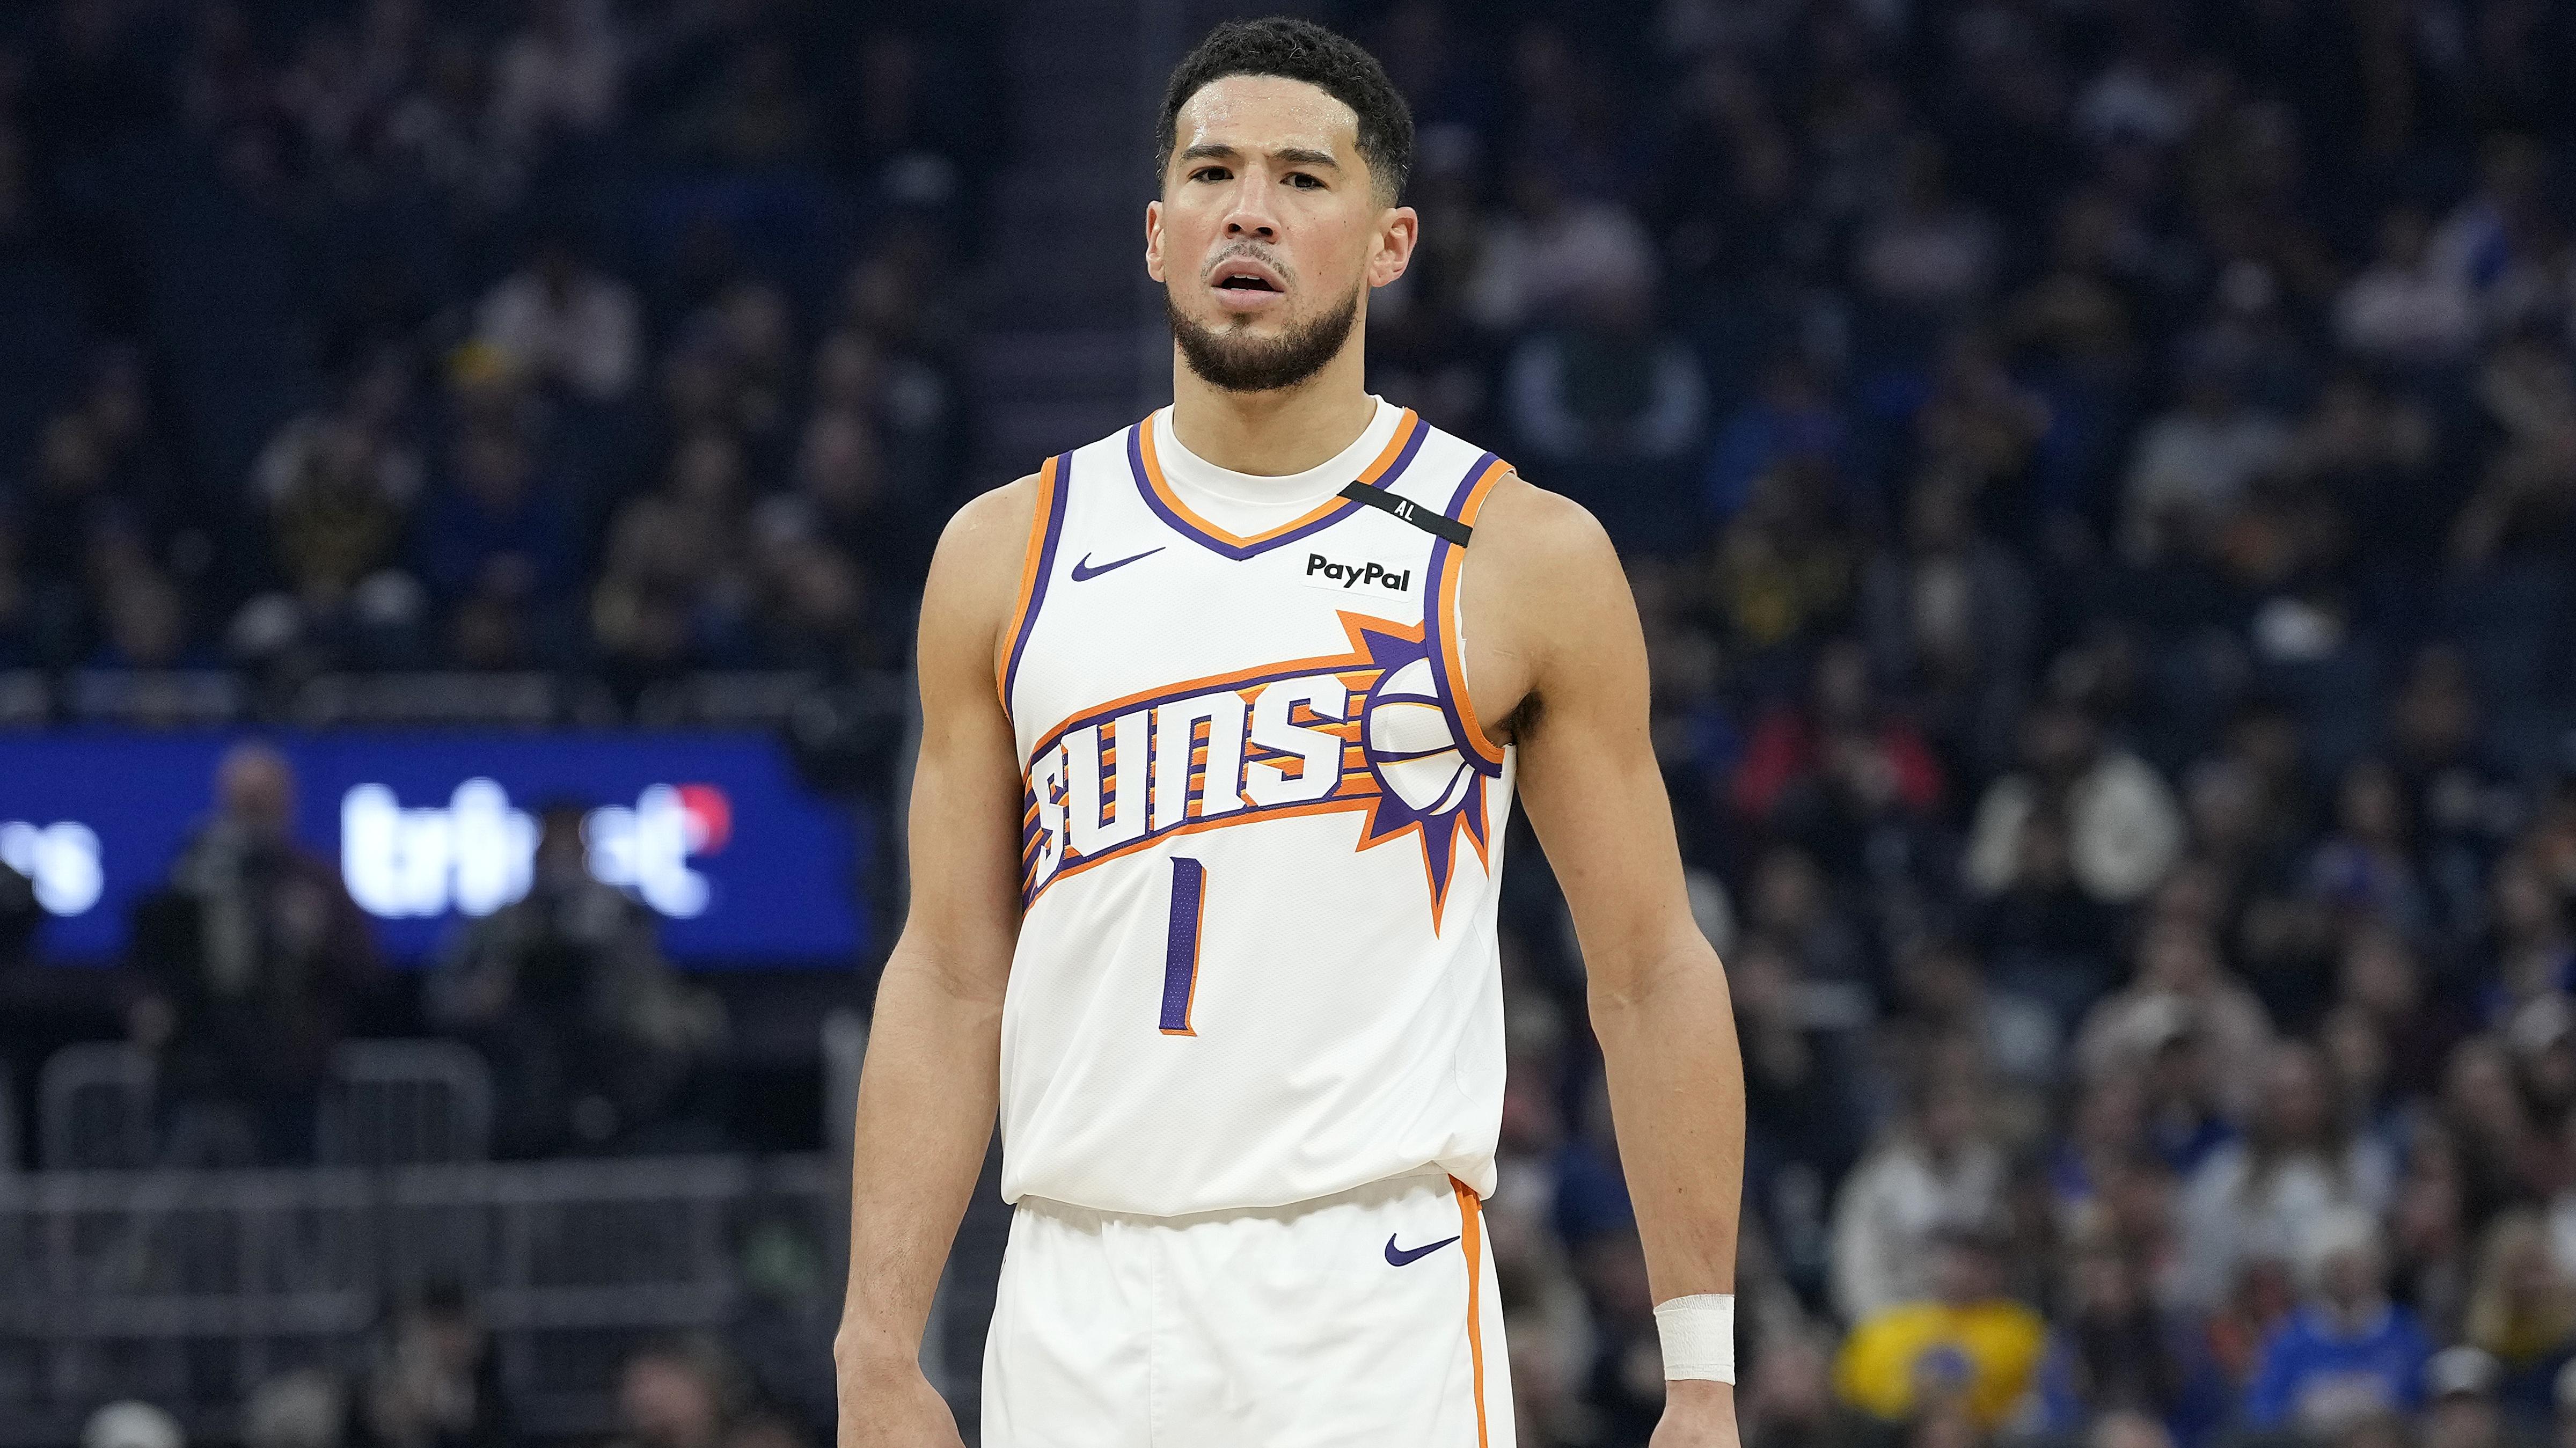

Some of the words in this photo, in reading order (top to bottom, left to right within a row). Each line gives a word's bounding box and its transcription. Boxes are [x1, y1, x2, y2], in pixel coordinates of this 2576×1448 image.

[1394, 500, 1413, 521] AL
[1306, 553, 1411, 591] PayPal
[1030, 675, 1350, 888] SUNS
[1159, 856, 1207, 1037] 1
